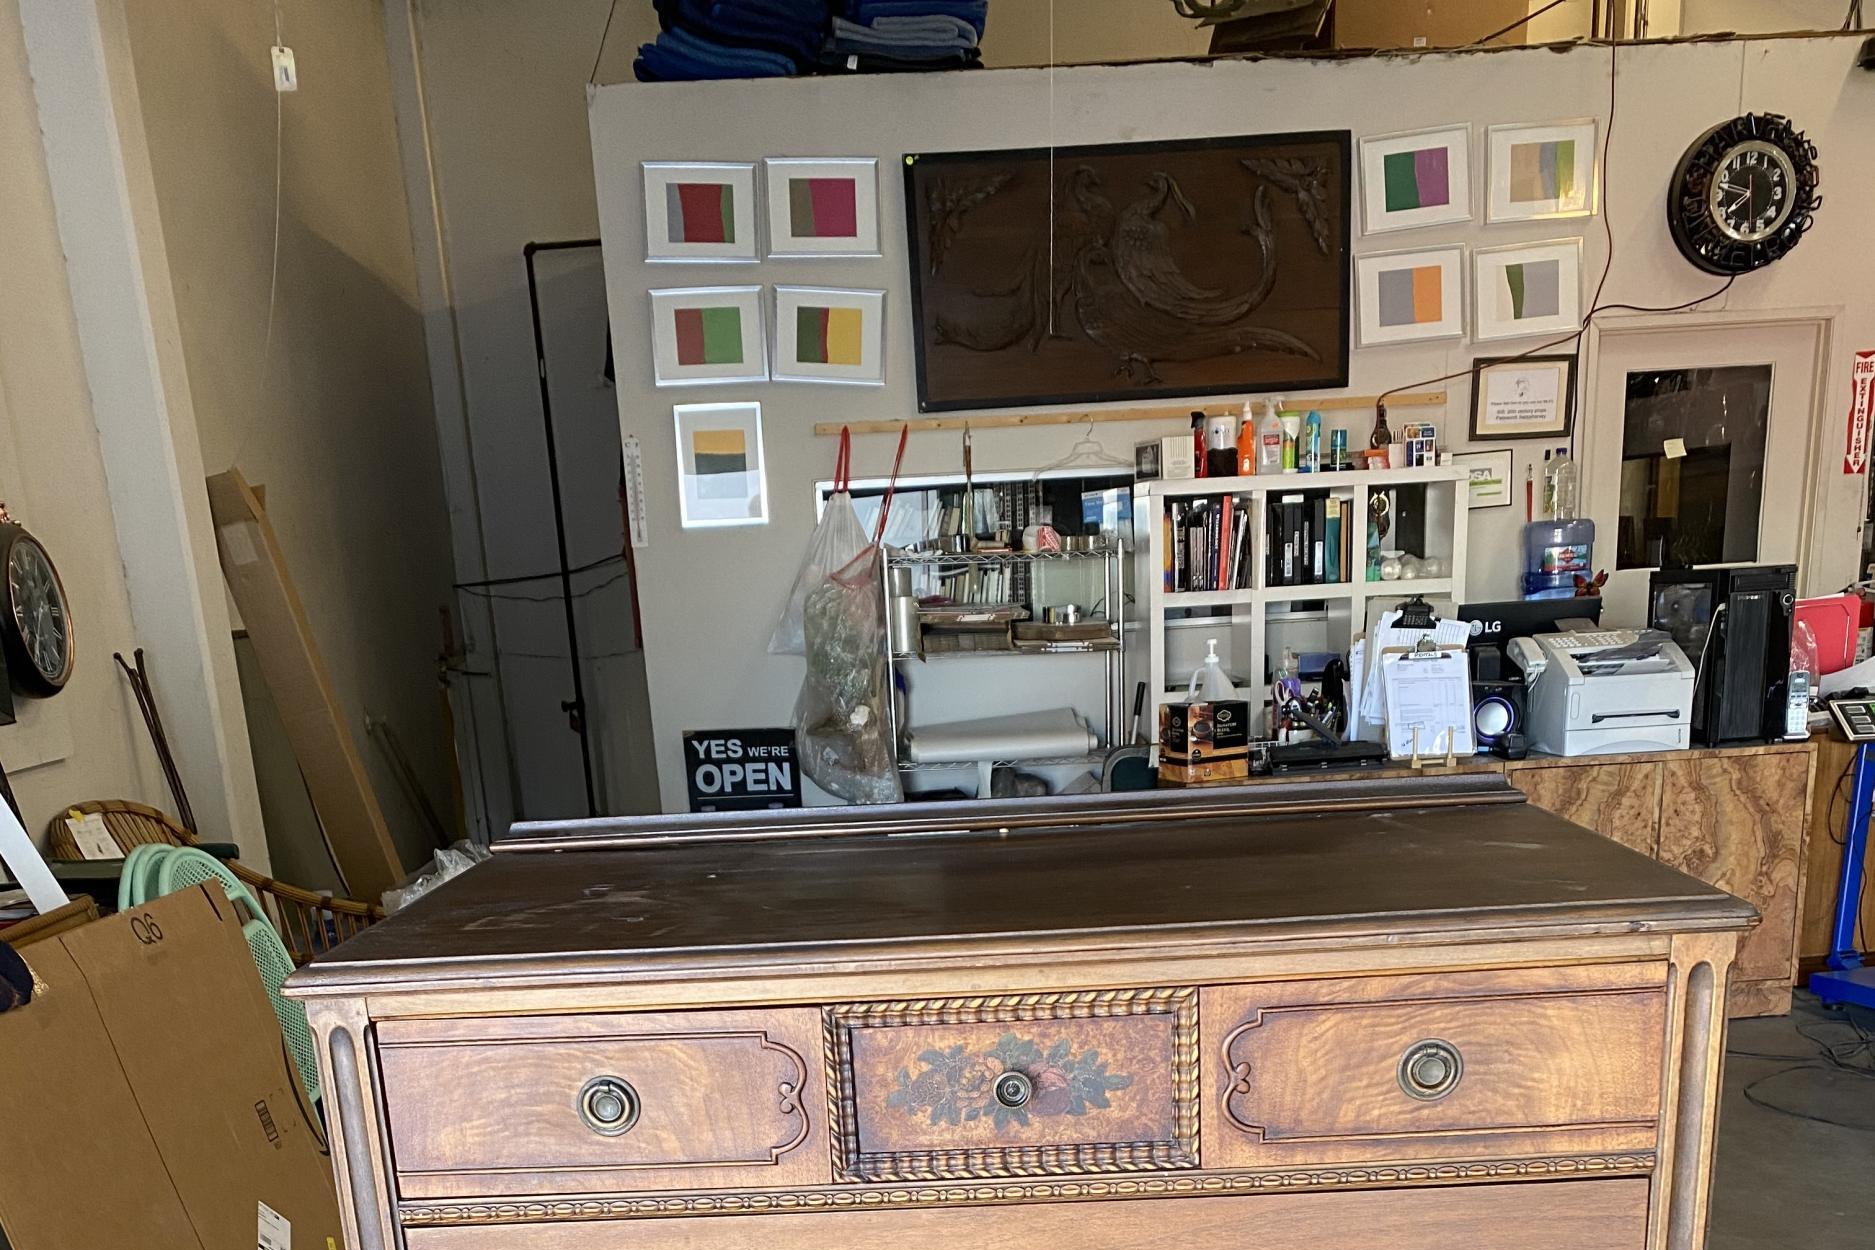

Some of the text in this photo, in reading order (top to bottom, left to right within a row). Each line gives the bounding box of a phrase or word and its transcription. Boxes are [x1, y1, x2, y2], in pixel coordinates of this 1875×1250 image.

[1746, 151, 1758, 165] 12
[1773, 168, 1781, 181] 2
[1773, 186, 1782, 200] 3
[1856, 361, 1874, 373] FIRE
[1853, 378, 1867, 466] EXTINGUISHER
[1484, 620, 1502, 633] LG
[692, 739, 789, 759] YES WE'RE
[695, 762, 792, 793] OPEN
[130, 912, 163, 945] Q6
